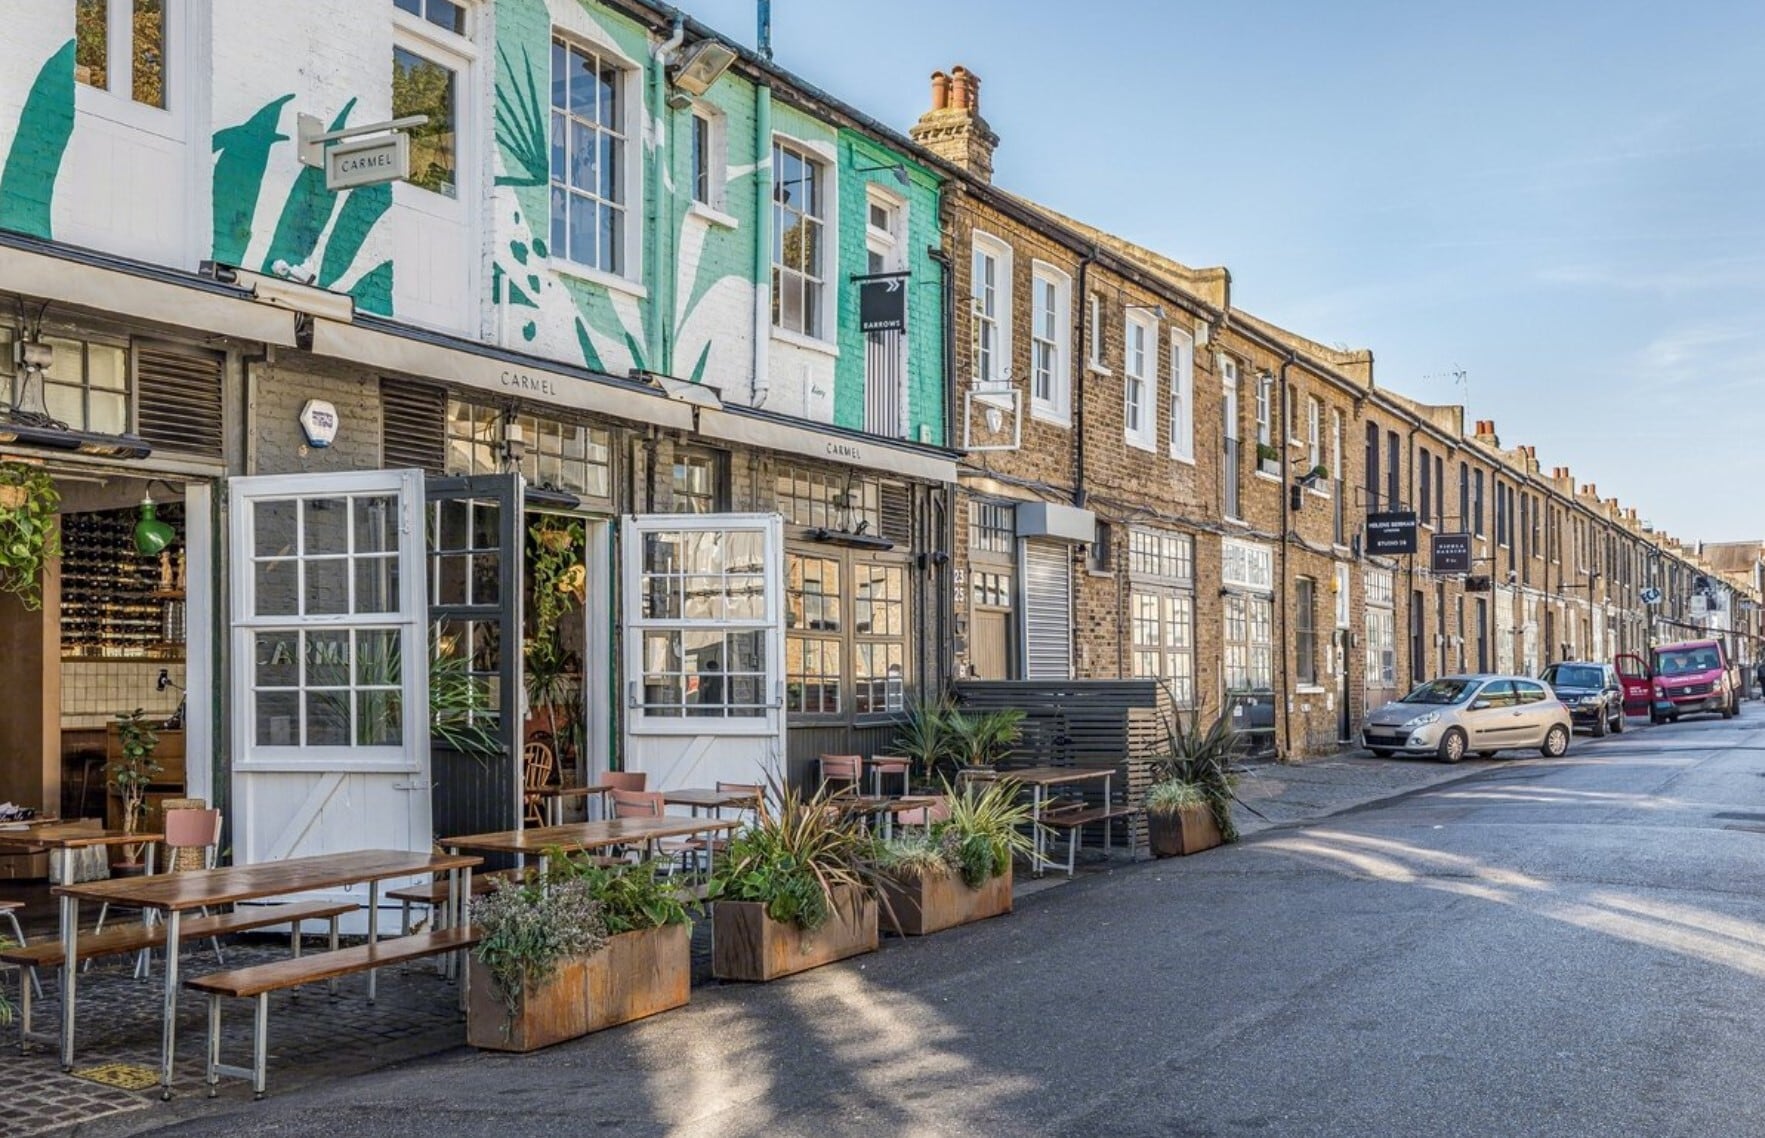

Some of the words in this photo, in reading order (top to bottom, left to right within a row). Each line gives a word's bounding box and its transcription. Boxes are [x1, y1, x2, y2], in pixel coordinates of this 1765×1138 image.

[341, 153, 392, 172] CARMEL
[501, 371, 557, 396] CARMEL
[826, 442, 861, 460] CARMEL
[954, 569, 964, 583] 23
[954, 587, 964, 601] 25
